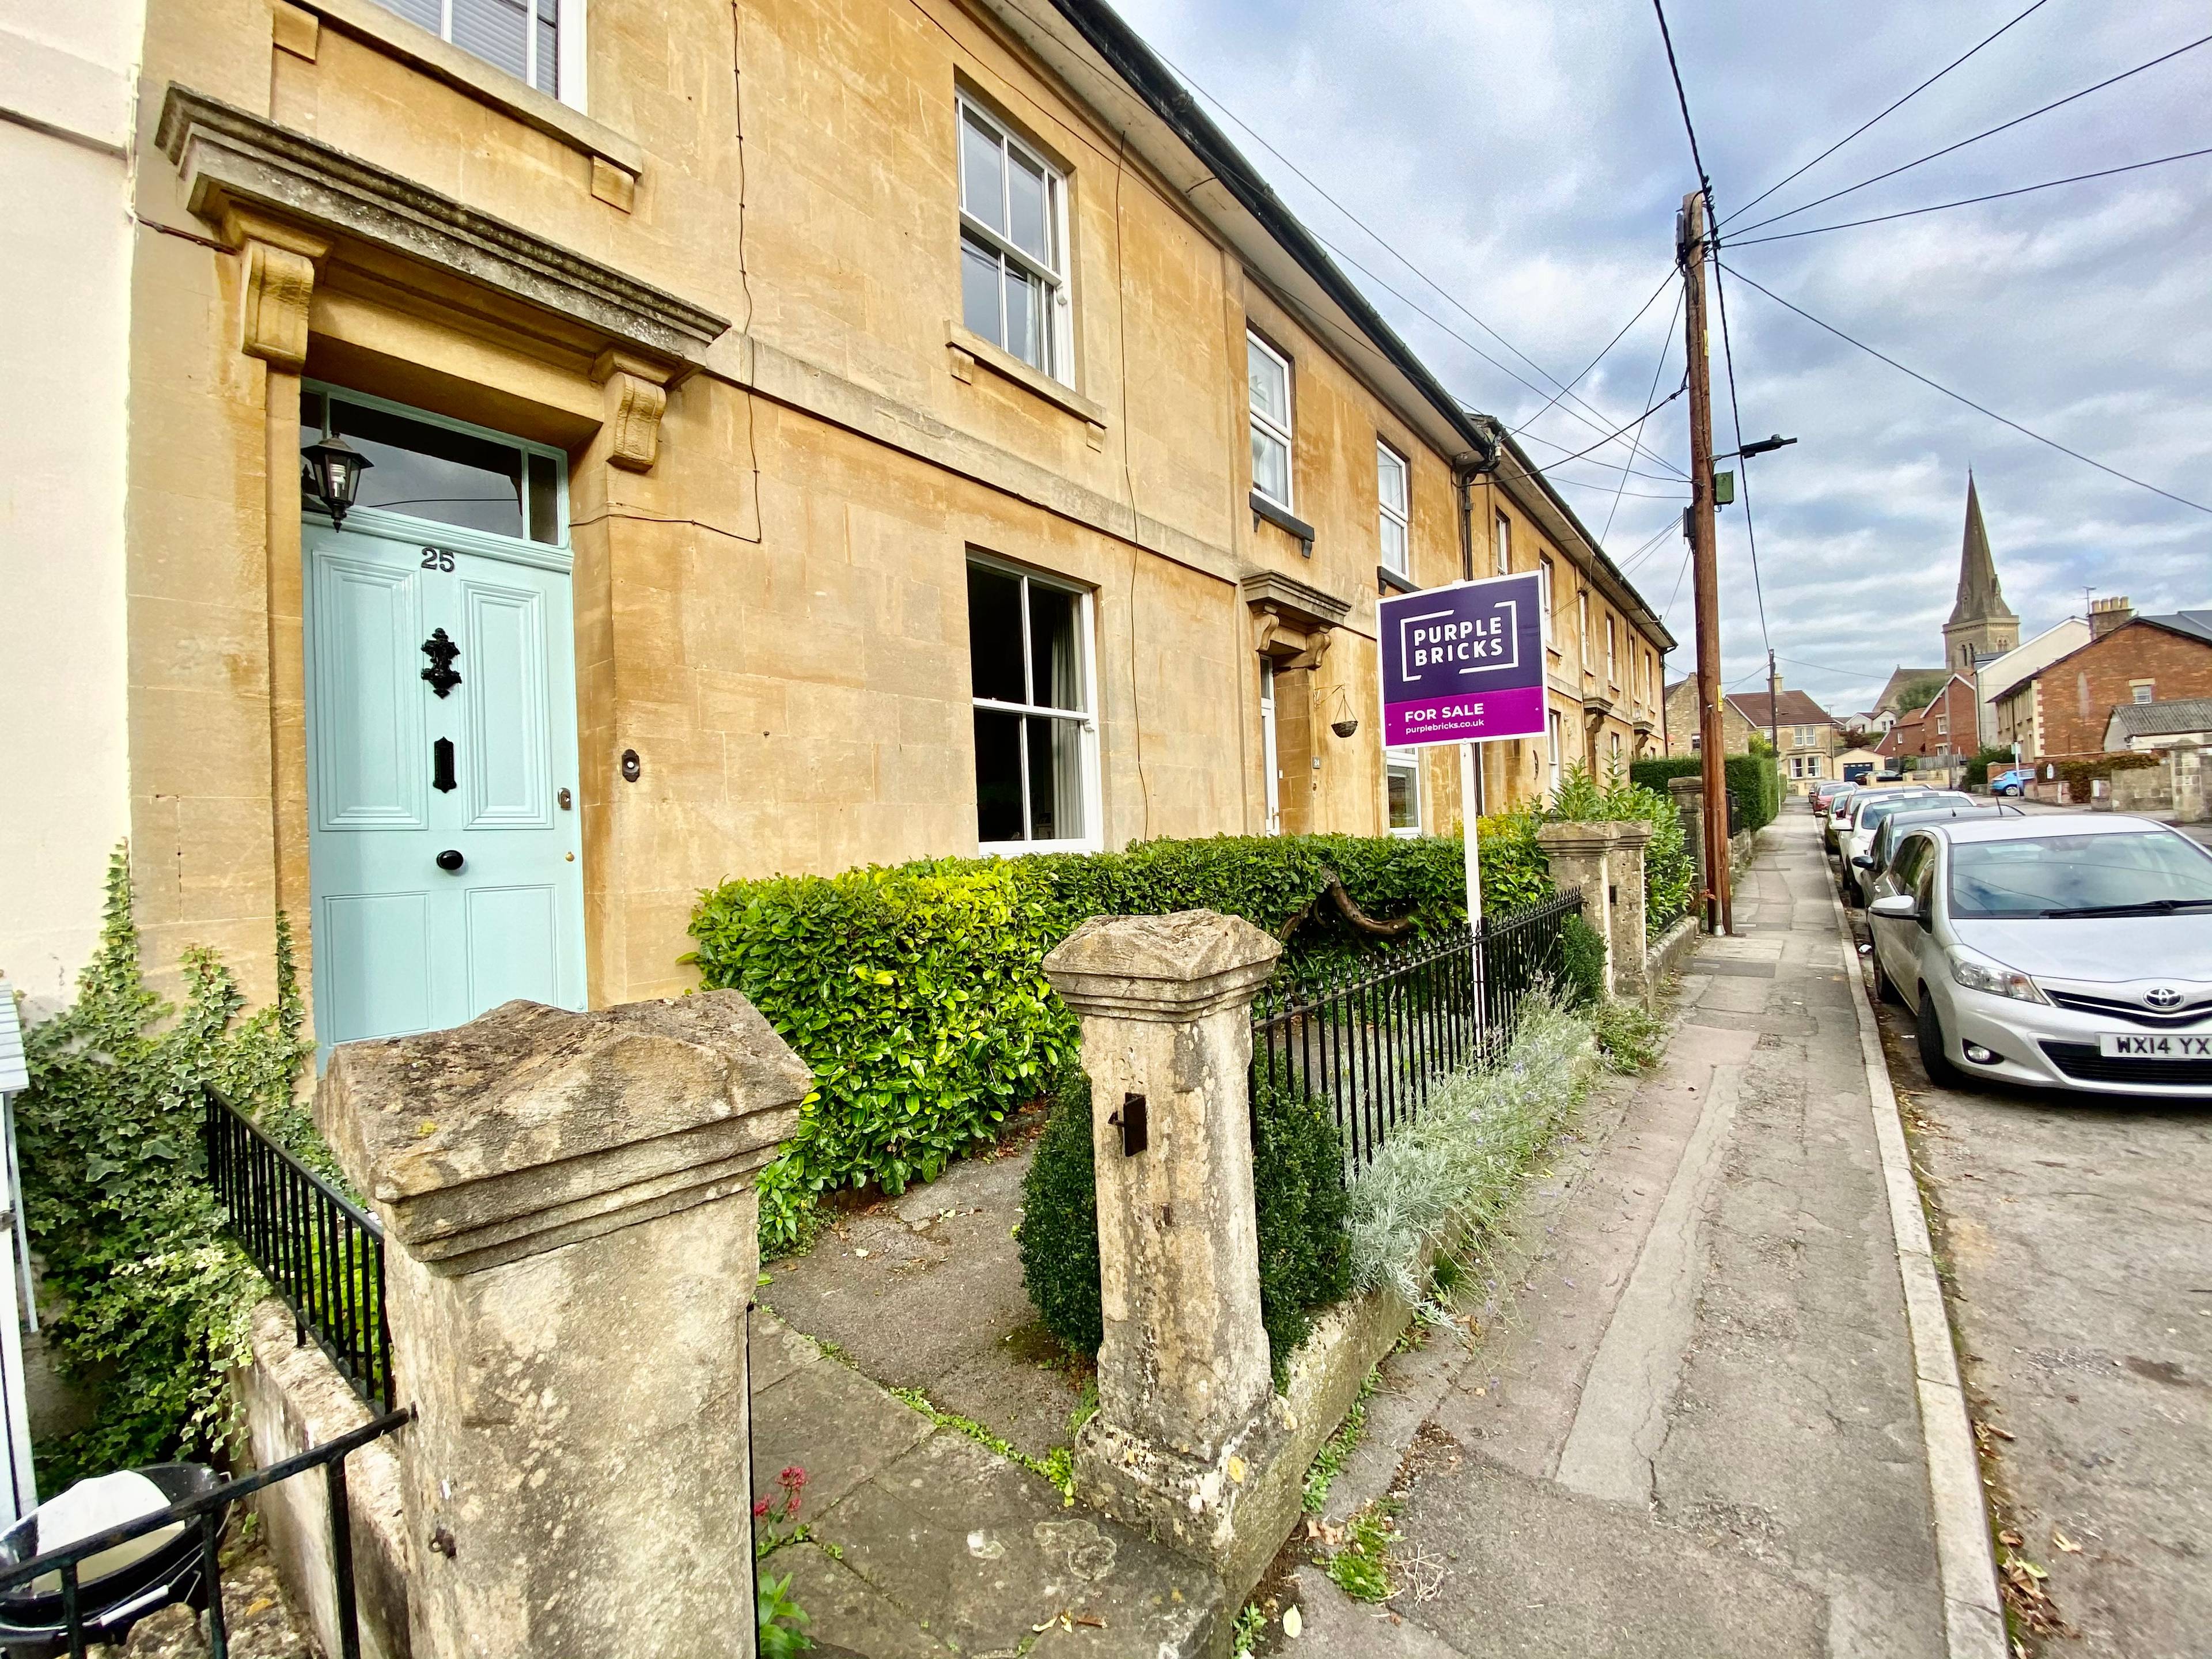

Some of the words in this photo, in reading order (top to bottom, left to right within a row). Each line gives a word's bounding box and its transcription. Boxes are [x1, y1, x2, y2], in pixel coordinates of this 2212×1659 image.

[421, 547, 454, 572] 25
[1414, 616, 1502, 646] PURPLE
[1415, 638, 1503, 667] BRICKS
[1405, 709, 1437, 722] FOR
[1442, 703, 1484, 718] SALE
[1406, 718, 1484, 735] purplebricks.co.uk
[2117, 1036, 2171, 1054] WX14
